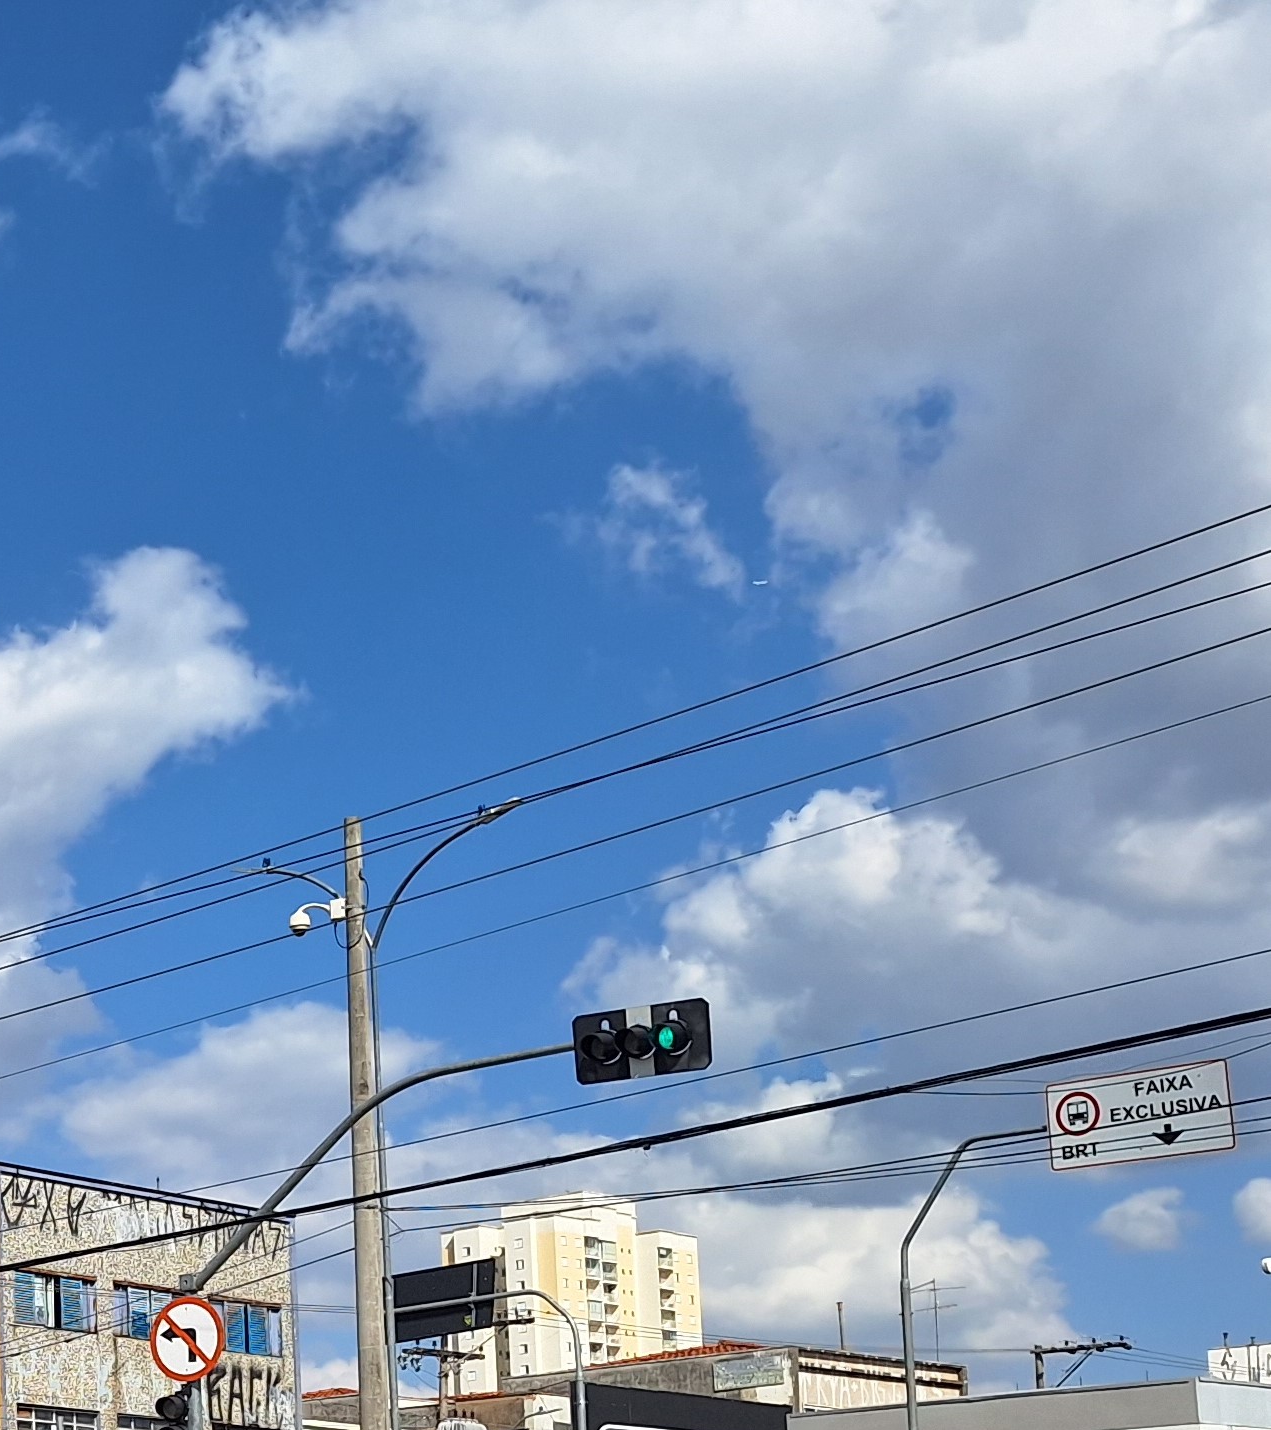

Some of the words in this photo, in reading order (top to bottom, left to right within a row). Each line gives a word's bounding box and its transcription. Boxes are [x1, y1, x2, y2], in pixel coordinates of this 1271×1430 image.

[1133, 1074, 1193, 1097] FAIXA
[1109, 1094, 1222, 1123] EXCLUSIVA
[1061, 1142, 1100, 1160] BRT
